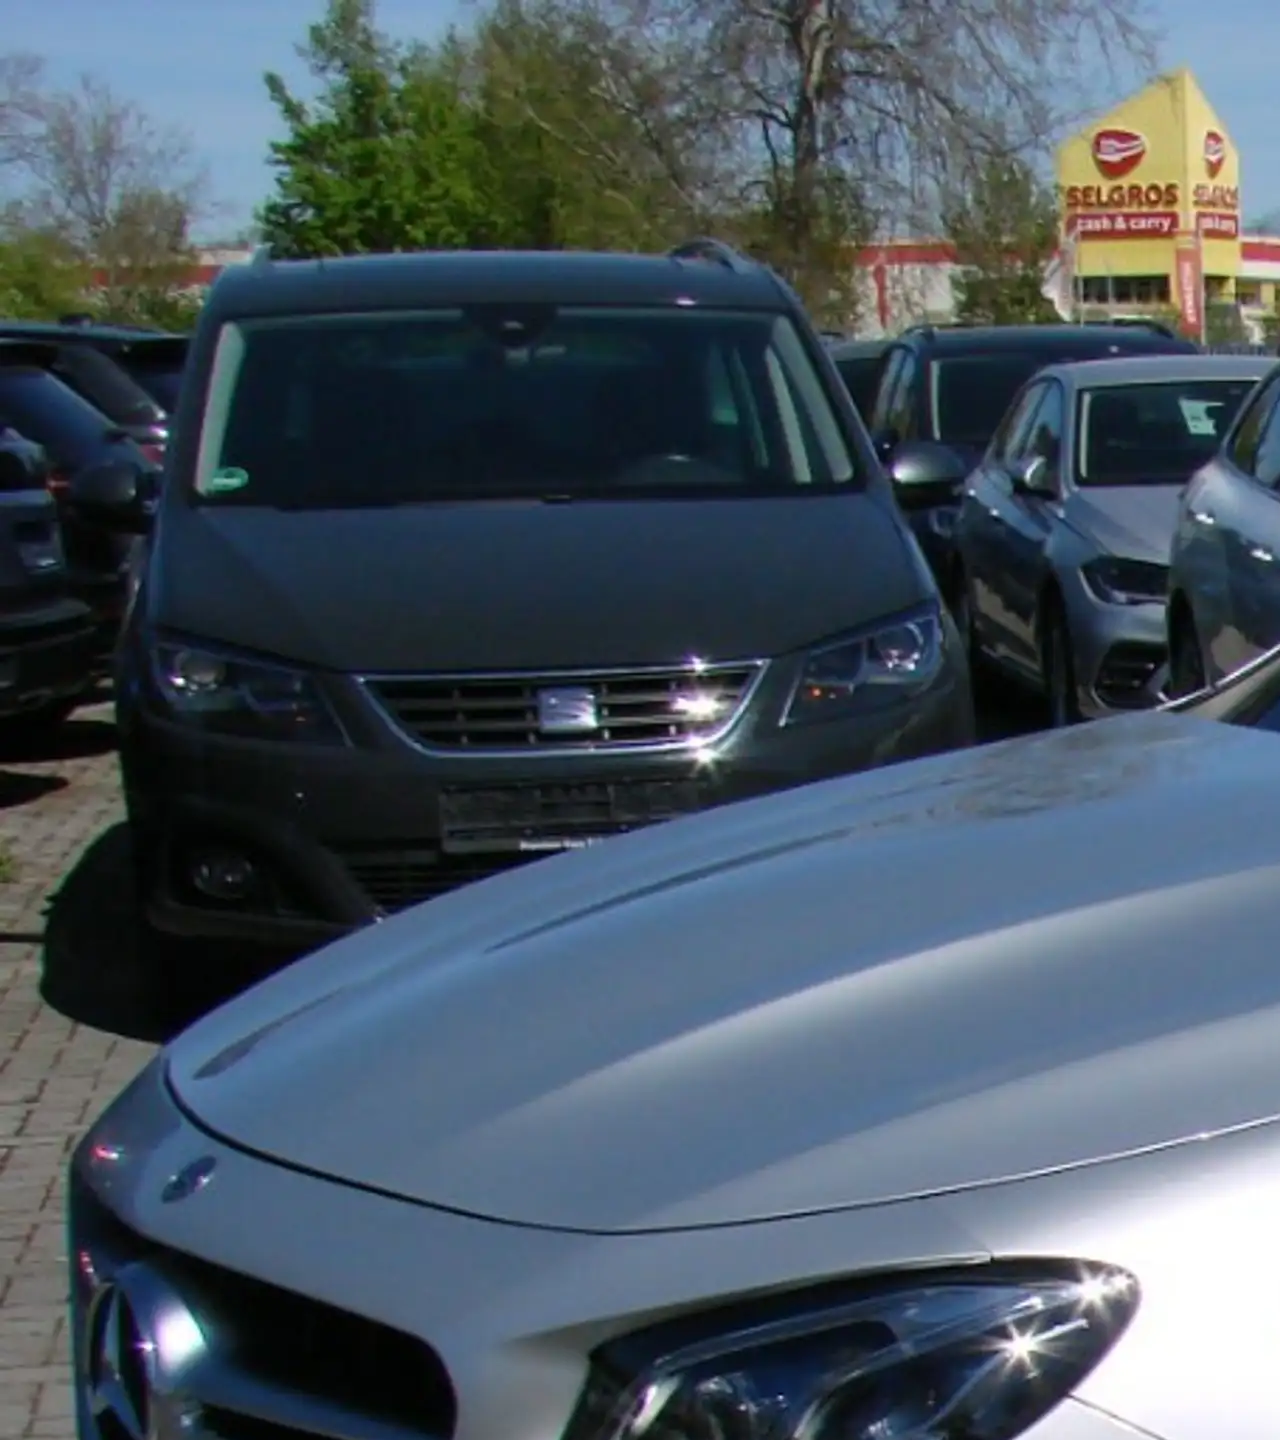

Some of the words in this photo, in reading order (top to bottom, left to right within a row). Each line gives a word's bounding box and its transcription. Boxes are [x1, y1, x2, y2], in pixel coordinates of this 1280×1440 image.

[1066, 184, 1179, 207] SELGROS
[1077, 216, 1112, 230] cash
[1114, 216, 1126, 229] &
[1130, 217, 1172, 232] carry
